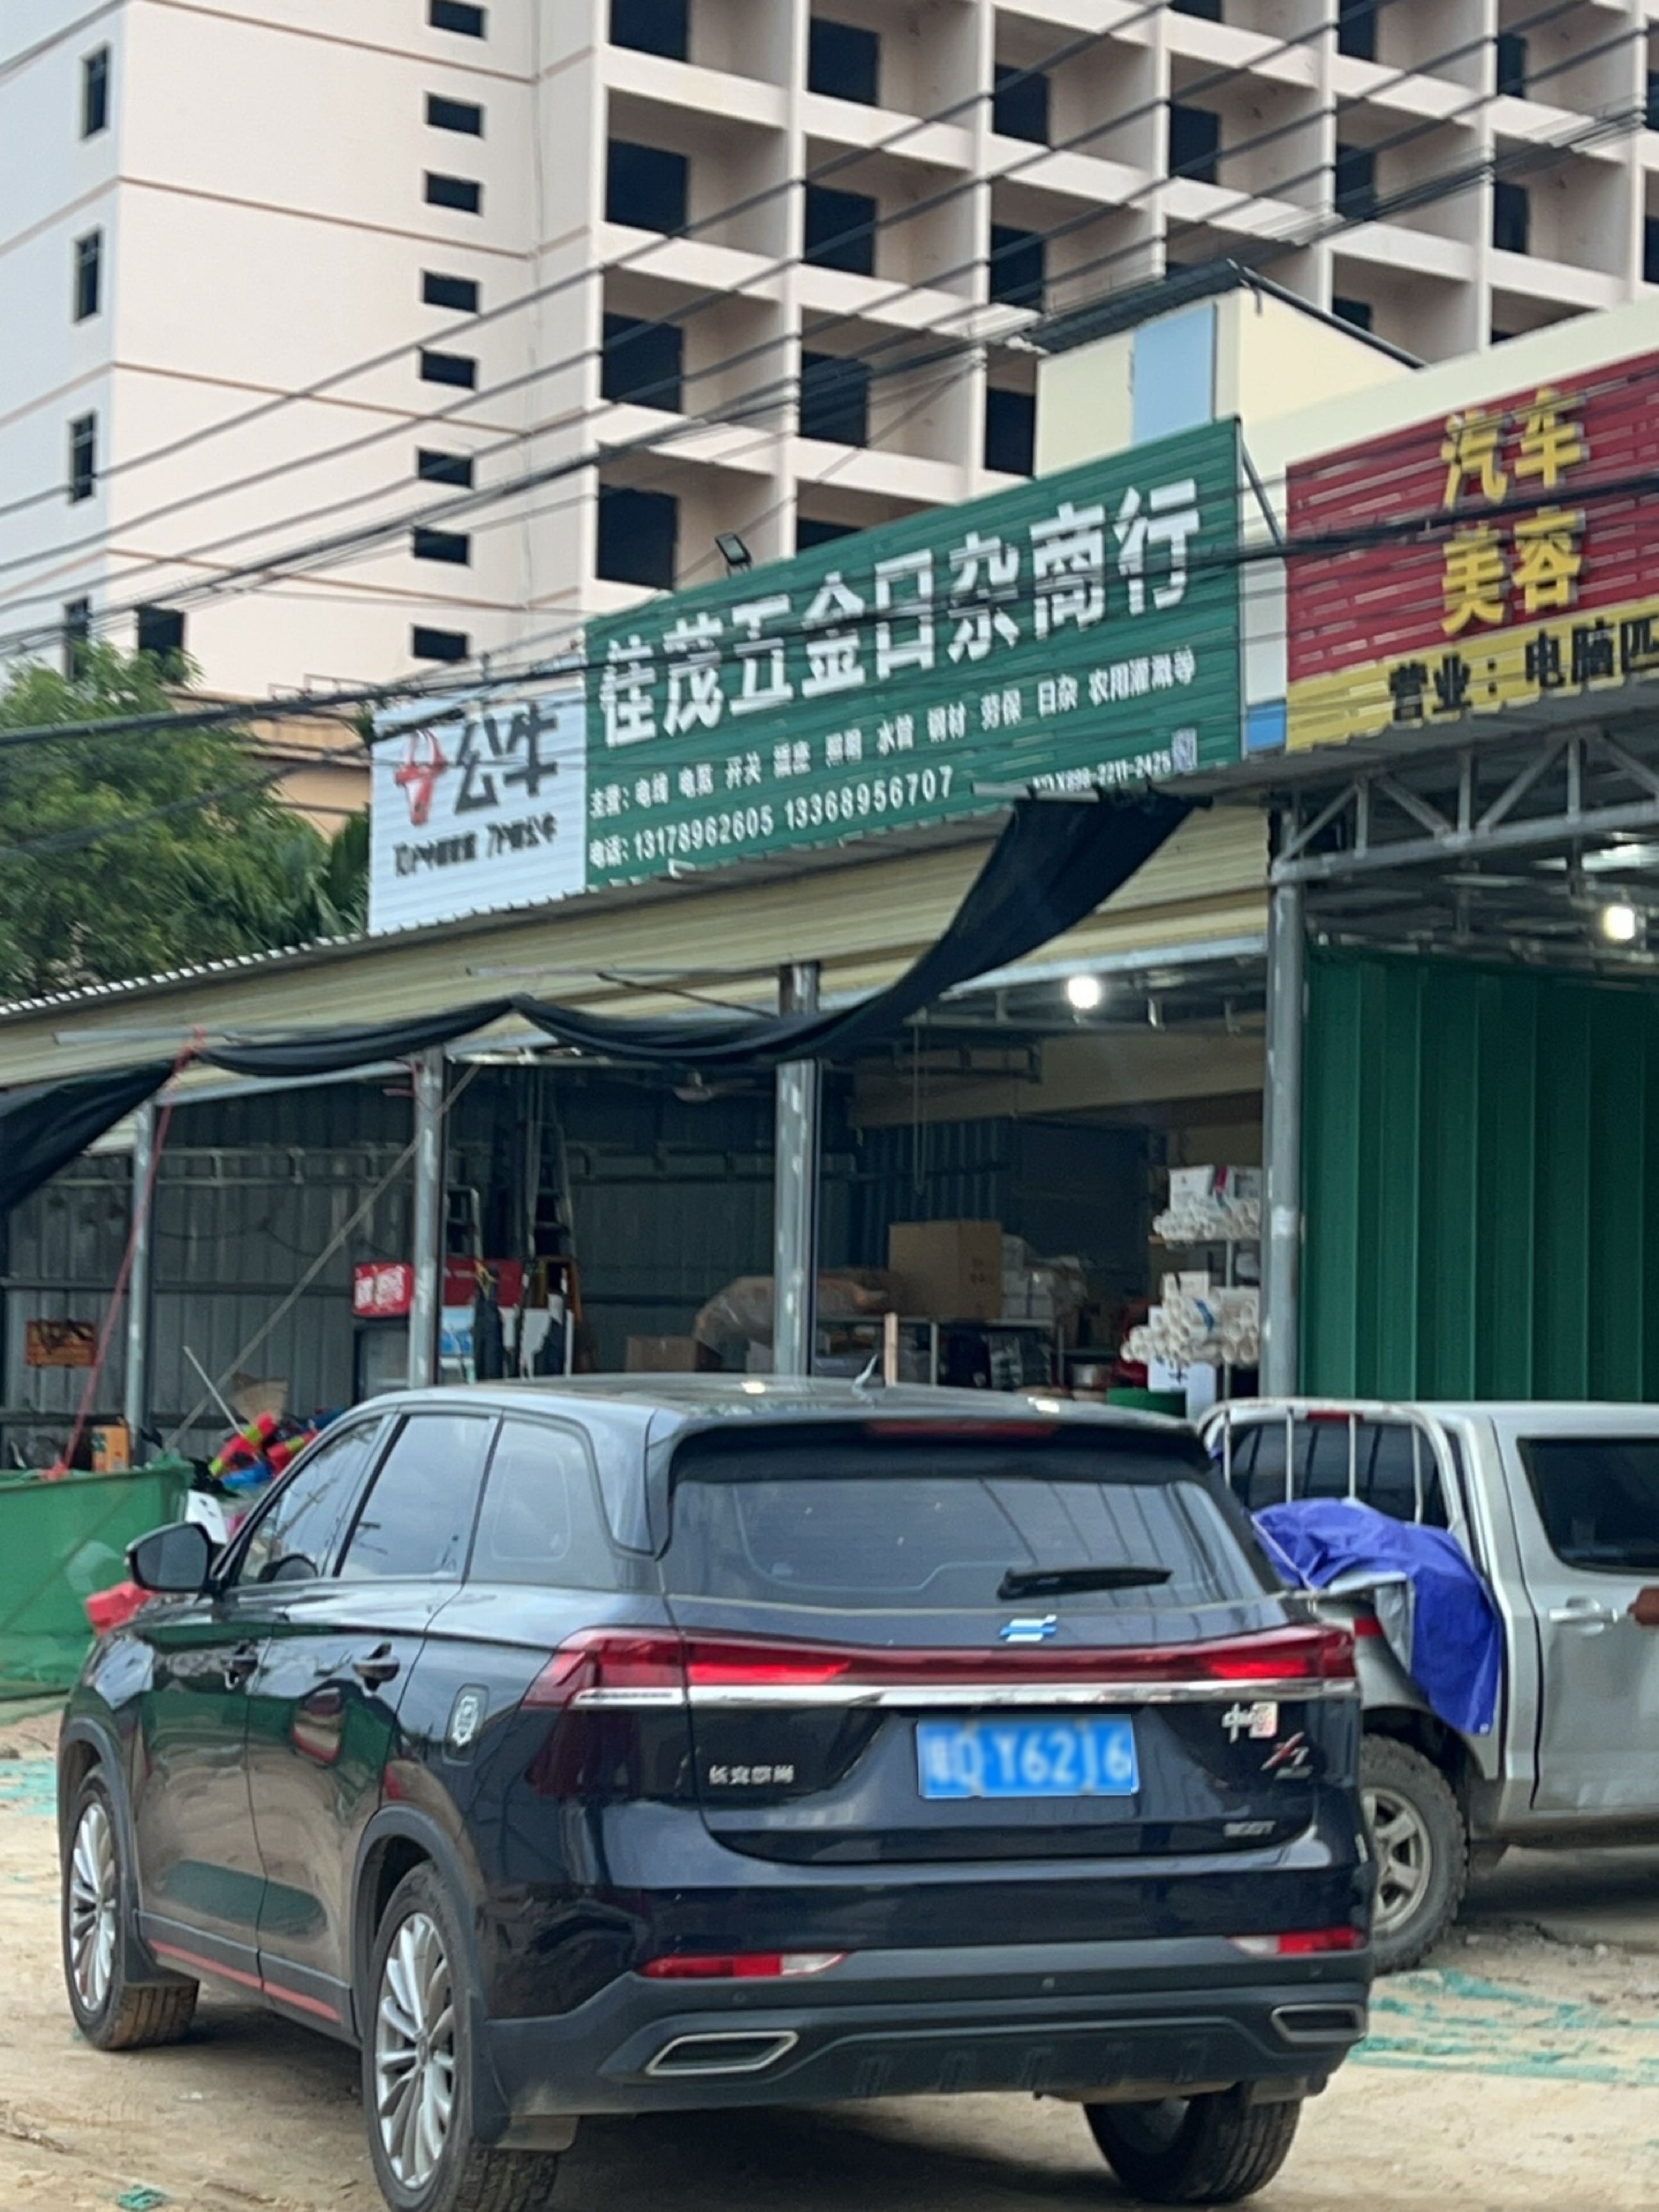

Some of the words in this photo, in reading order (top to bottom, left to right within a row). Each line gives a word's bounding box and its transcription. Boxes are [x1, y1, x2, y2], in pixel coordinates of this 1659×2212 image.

[1440, 387, 1590, 508] 汽车
[1441, 506, 1585, 635] 美容
[454, 701, 558, 814] 公牛
[785, 765, 953, 831] 13368956707
